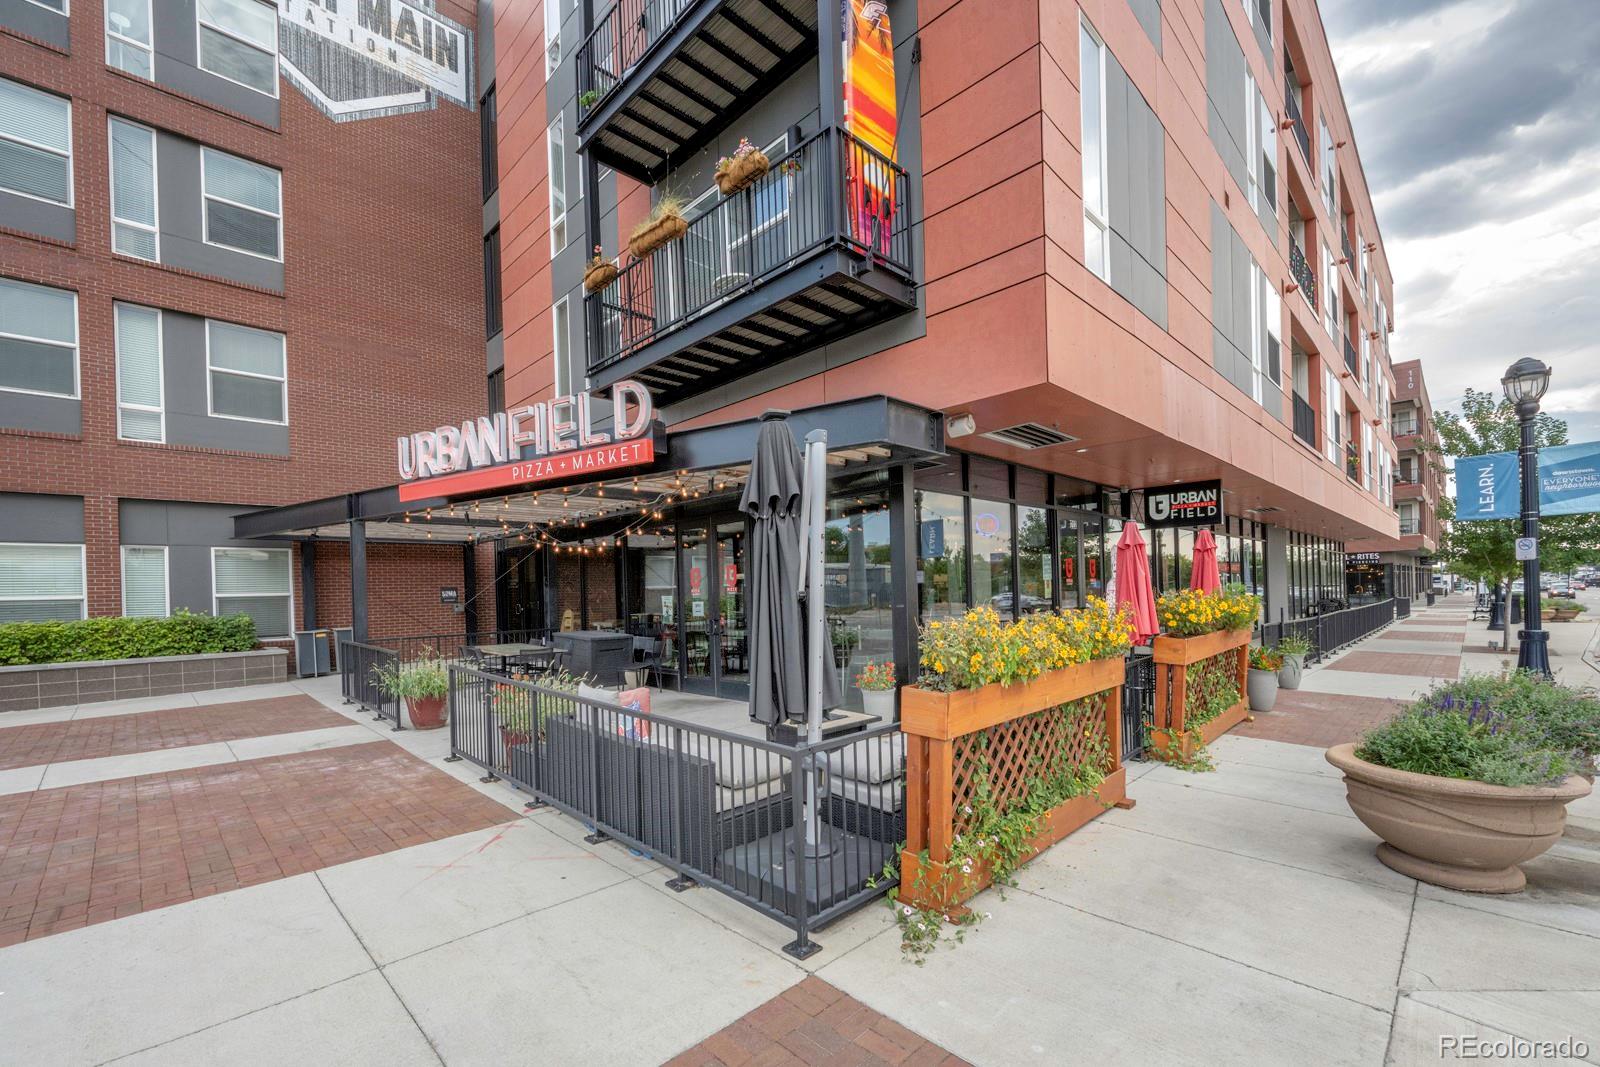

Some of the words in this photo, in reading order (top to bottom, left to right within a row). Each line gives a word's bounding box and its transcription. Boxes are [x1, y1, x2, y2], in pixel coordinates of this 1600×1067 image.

[512, 461, 554, 480] PIZZA
[572, 444, 640, 470] MARKET
[1171, 489, 1216, 504] URBAN
[1478, 463, 1495, 512] LEARN.
[1171, 506, 1216, 519] FIELD
